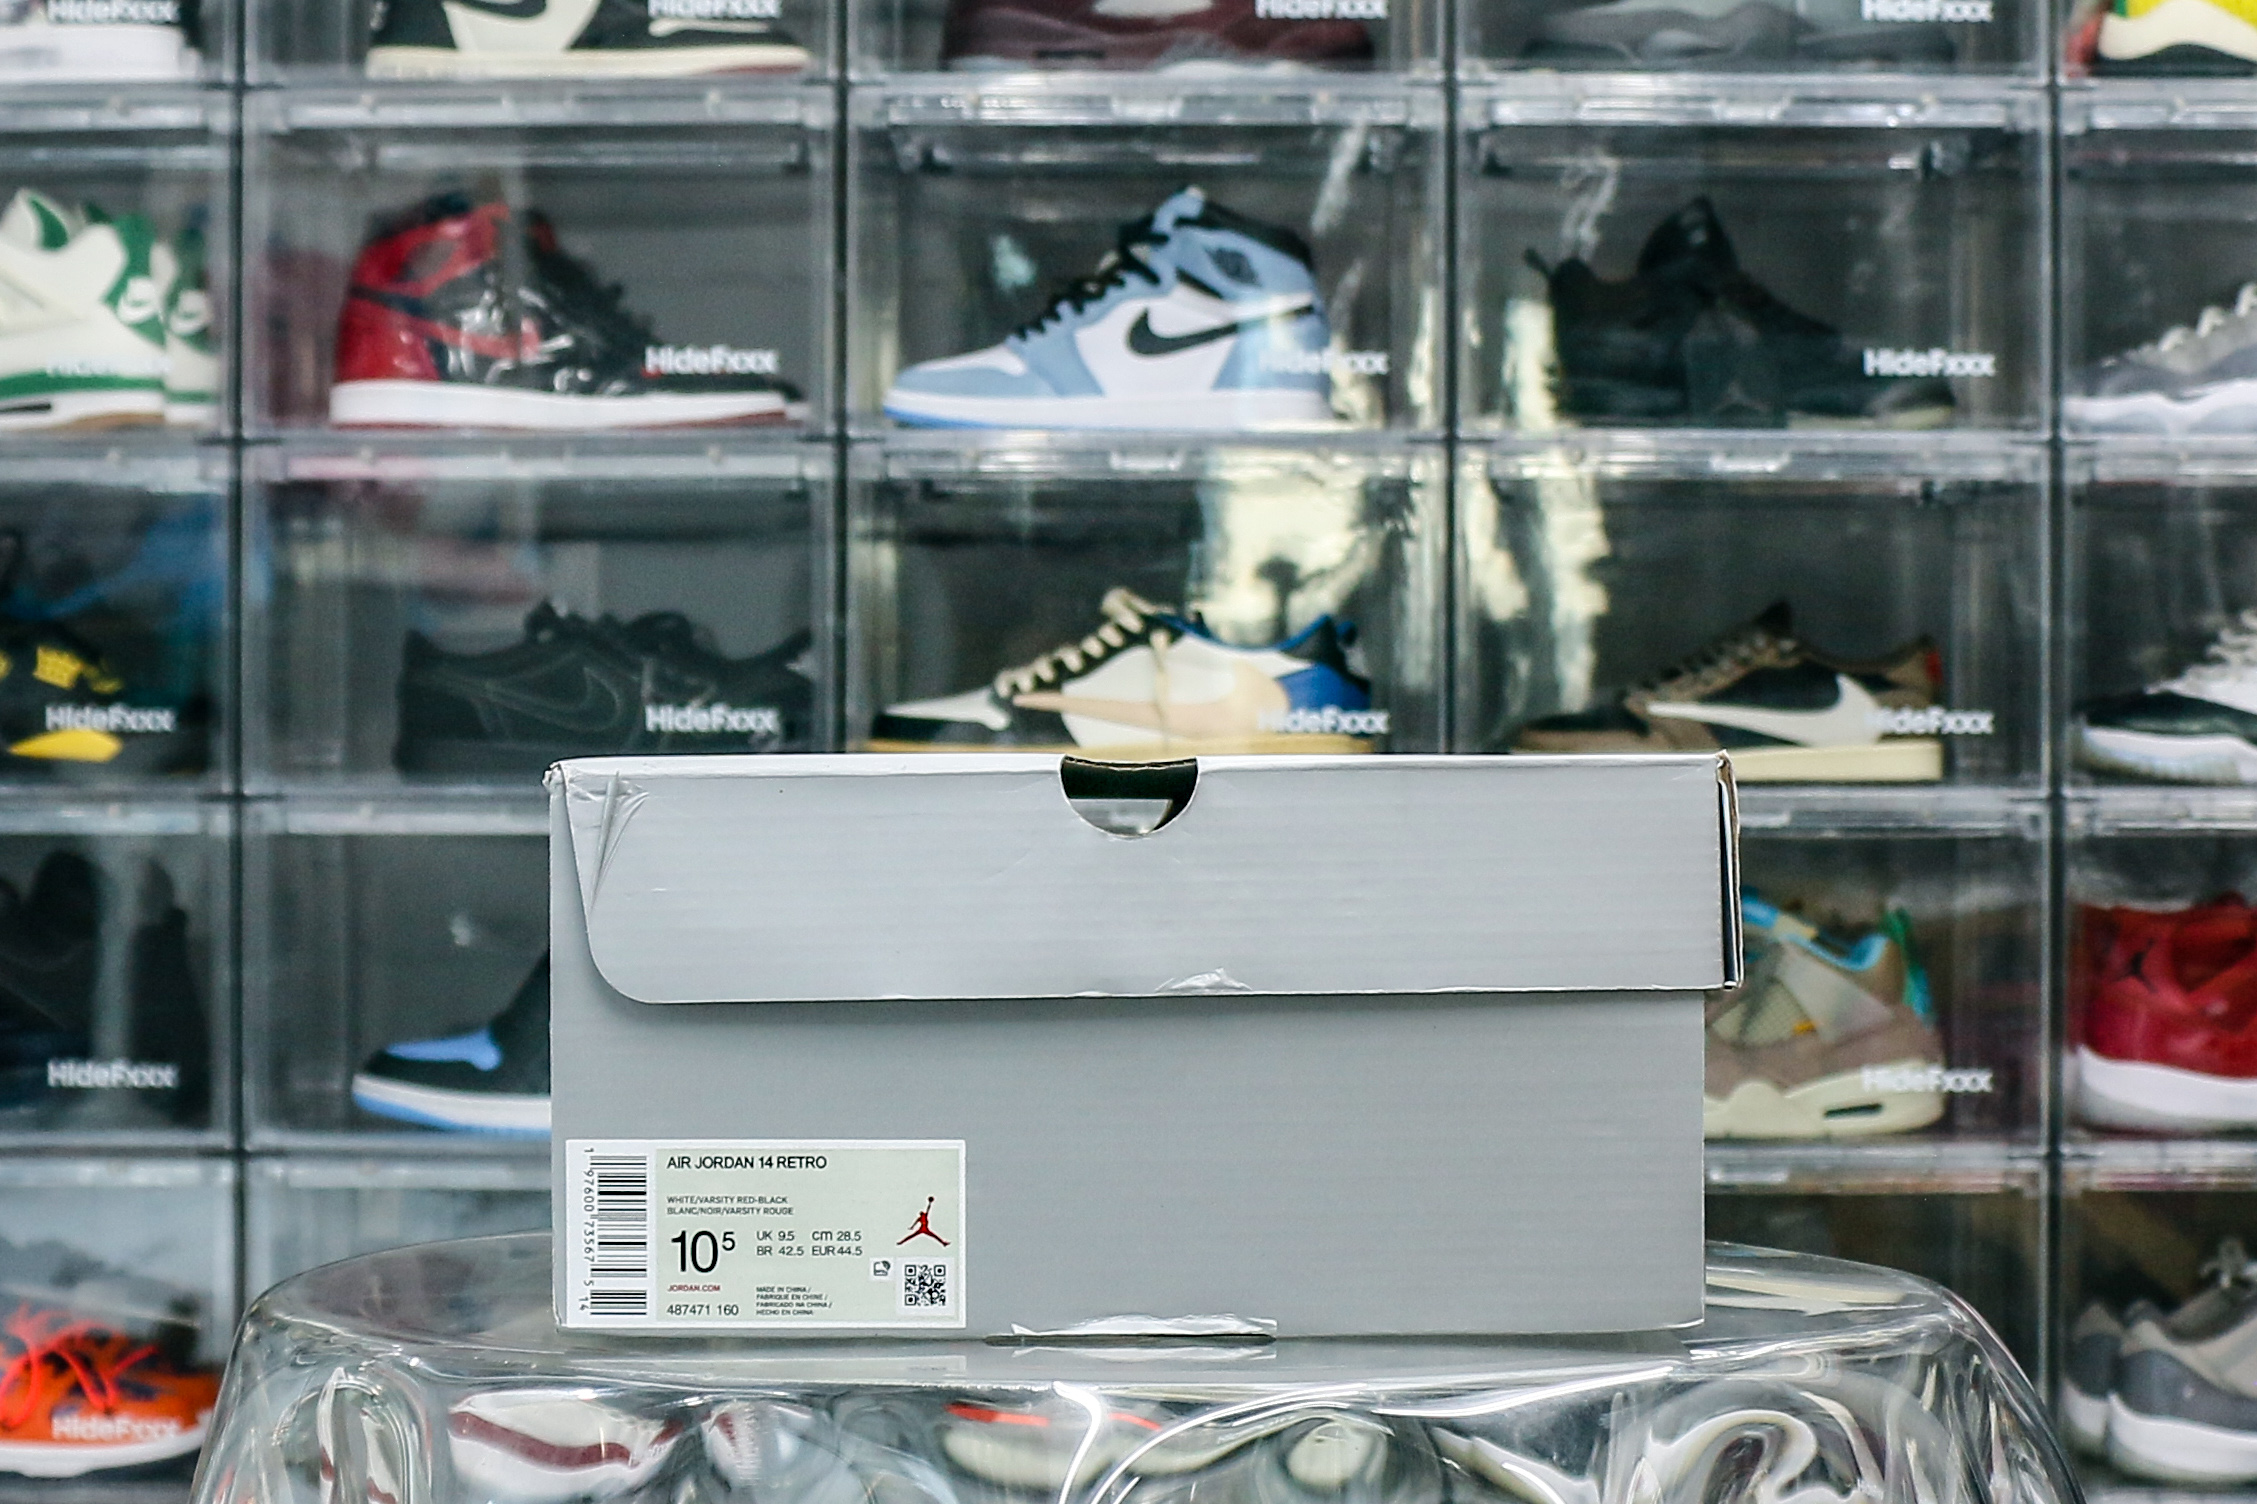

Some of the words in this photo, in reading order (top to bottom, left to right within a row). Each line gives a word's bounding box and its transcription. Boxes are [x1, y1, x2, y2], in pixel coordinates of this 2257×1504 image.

[645, 345, 778, 374] HideFxxx
[1863, 347, 1995, 376] HideFxxx
[45, 705, 176, 731] HideFxxx
[645, 703, 779, 732] HideFxxx
[47, 1058, 179, 1088] HideFxxx
[667, 1156, 691, 1169] AIR
[695, 1156, 754, 1169] JORDAN
[759, 1156, 773, 1169] 14
[777, 1156, 827, 1169] RETRO
[584, 1169, 595, 1212] 97600
[667, 1196, 734, 1204] WHITE/VARSITY
[737, 1196, 788, 1204] RED-BLACK
[667, 1207, 760, 1215] BLANC/NOIR/VARSITY
[763, 1207, 794, 1215] ROUGE
[584, 1221, 595, 1262] 73567
[756, 1231, 773, 1241] UK
[778, 1231, 795, 1241] 9.5
[836, 1231, 862, 1241] 28.5
[756, 1246, 773, 1256] BR
[778, 1246, 804, 1256] 42.5
[811, 1246, 835, 1256] EUR
[837, 1246, 862, 1256] 44.5
[667, 1284, 720, 1292] JORDAN.COM
[666, 1304, 710, 1316] 487471
[716, 1304, 739, 1316] 160
